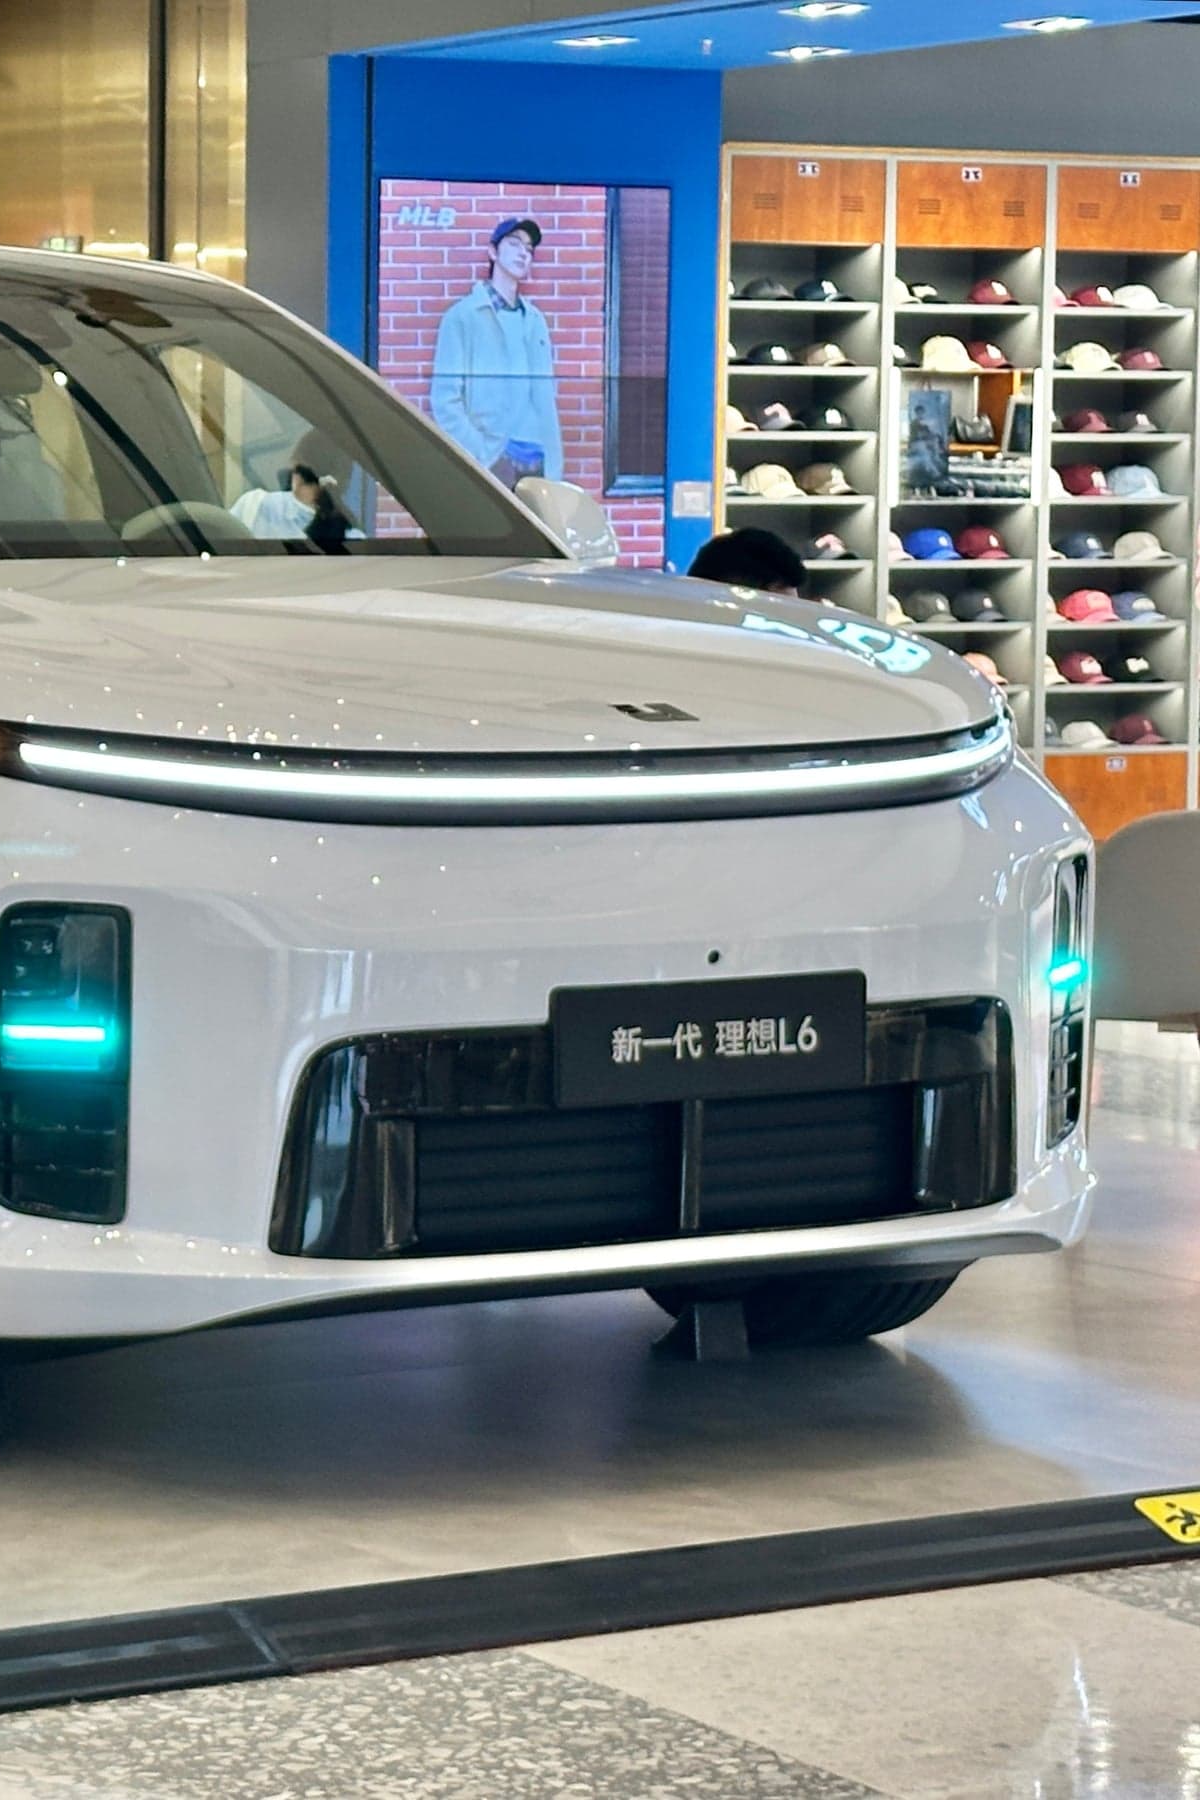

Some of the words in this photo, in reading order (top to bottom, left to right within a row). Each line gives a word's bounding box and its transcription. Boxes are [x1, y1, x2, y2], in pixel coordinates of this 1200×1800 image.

[398, 205, 457, 228] MLB
[611, 1023, 702, 1063] 新一代
[714, 1015, 818, 1057] 理想L6
